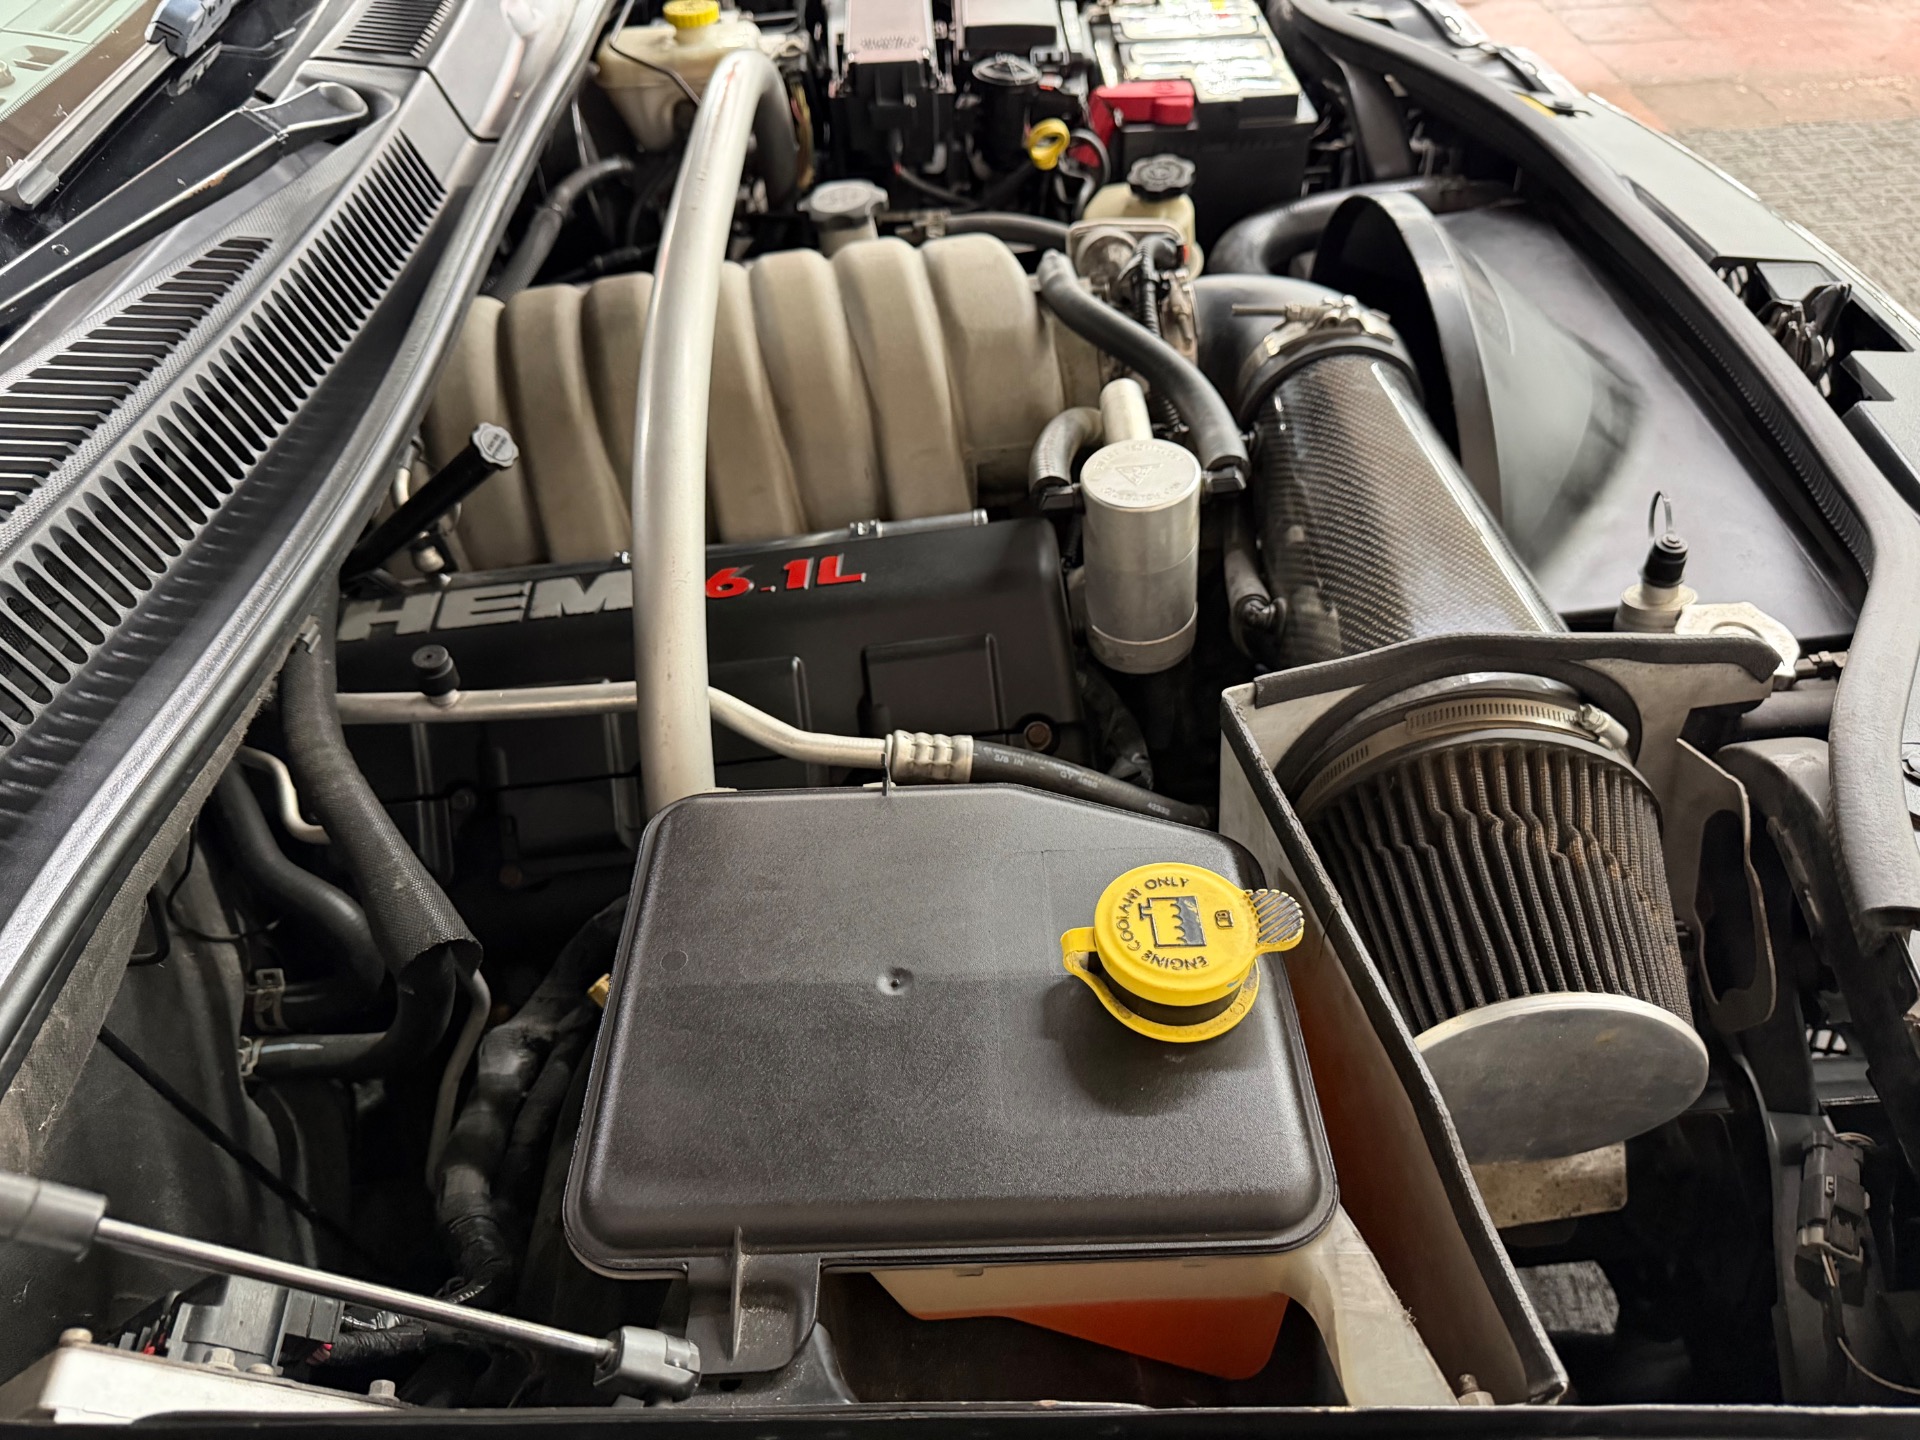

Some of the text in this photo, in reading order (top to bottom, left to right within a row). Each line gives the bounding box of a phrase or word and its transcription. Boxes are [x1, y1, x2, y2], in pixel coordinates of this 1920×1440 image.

[336, 553, 867, 641] HEM 6.1L
[1013, 757, 1024, 766] IN
[1116, 876, 1209, 971] ENGINE COOLANT ONLY
